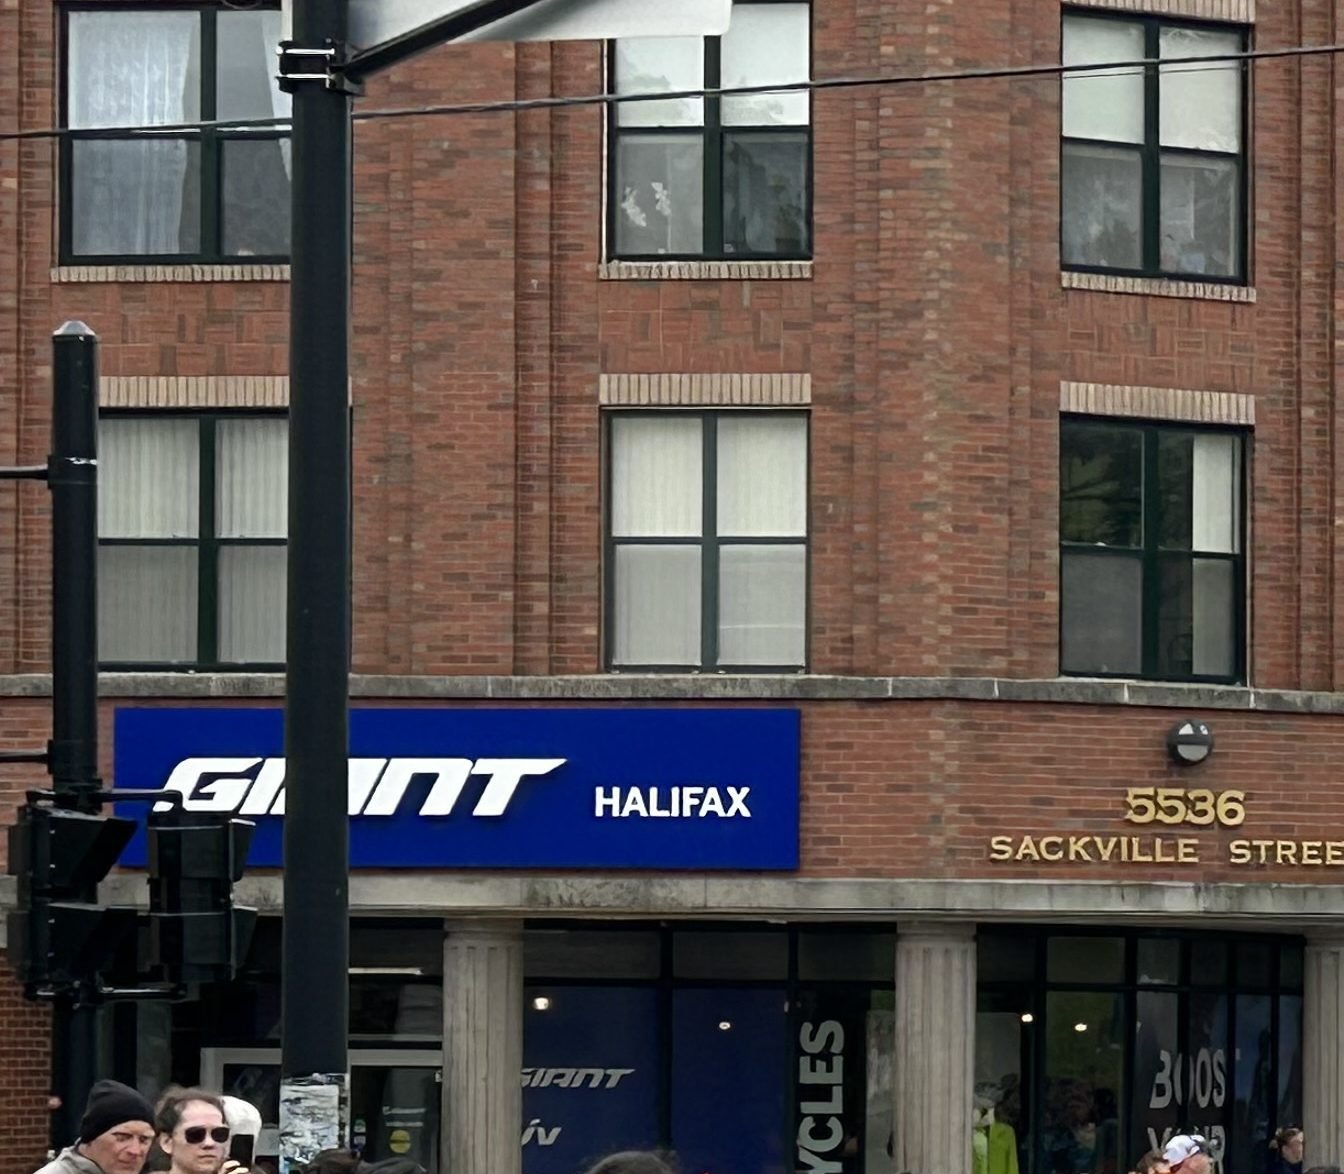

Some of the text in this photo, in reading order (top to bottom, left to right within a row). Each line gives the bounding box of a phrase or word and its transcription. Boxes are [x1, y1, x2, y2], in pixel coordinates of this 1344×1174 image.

[595, 785, 752, 818] HALIFAX
[1124, 786, 1246, 826] 5536
[989, 835, 1200, 864] SACKVILLE
